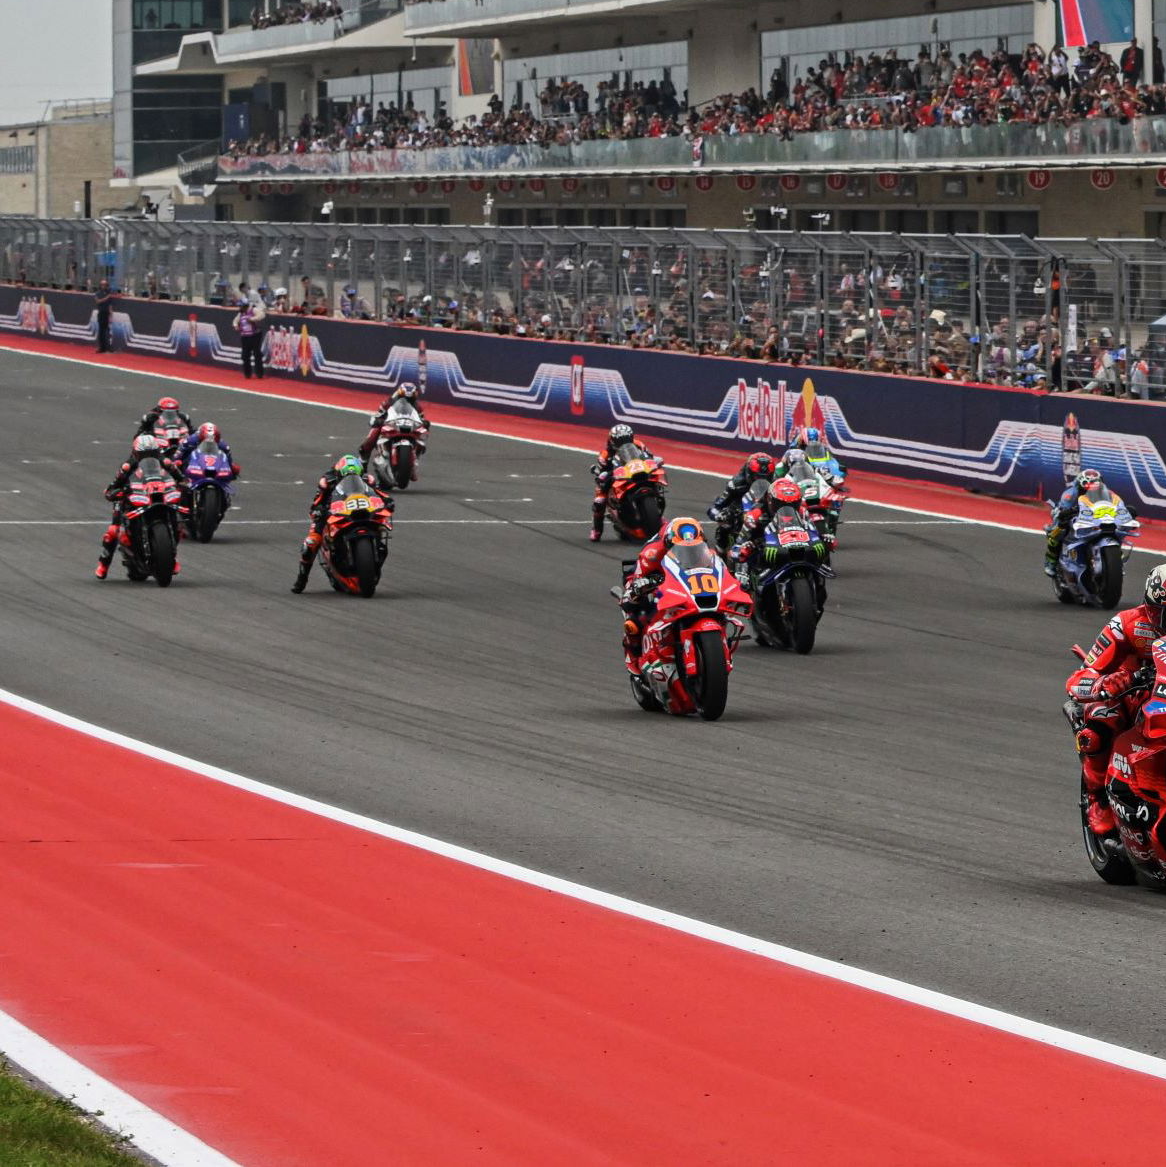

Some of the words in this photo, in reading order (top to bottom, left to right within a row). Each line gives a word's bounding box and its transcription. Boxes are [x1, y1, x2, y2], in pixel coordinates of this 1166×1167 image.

[833, 176, 841, 186] 17
[884, 175, 894, 186] 18
[1034, 172, 1045, 185] 19
[1097, 172, 1109, 185] 20
[739, 381, 763, 437] Red
[763, 385, 785, 441] Bull
[345, 499, 370, 510] 33
[688, 574, 720, 594] 10
